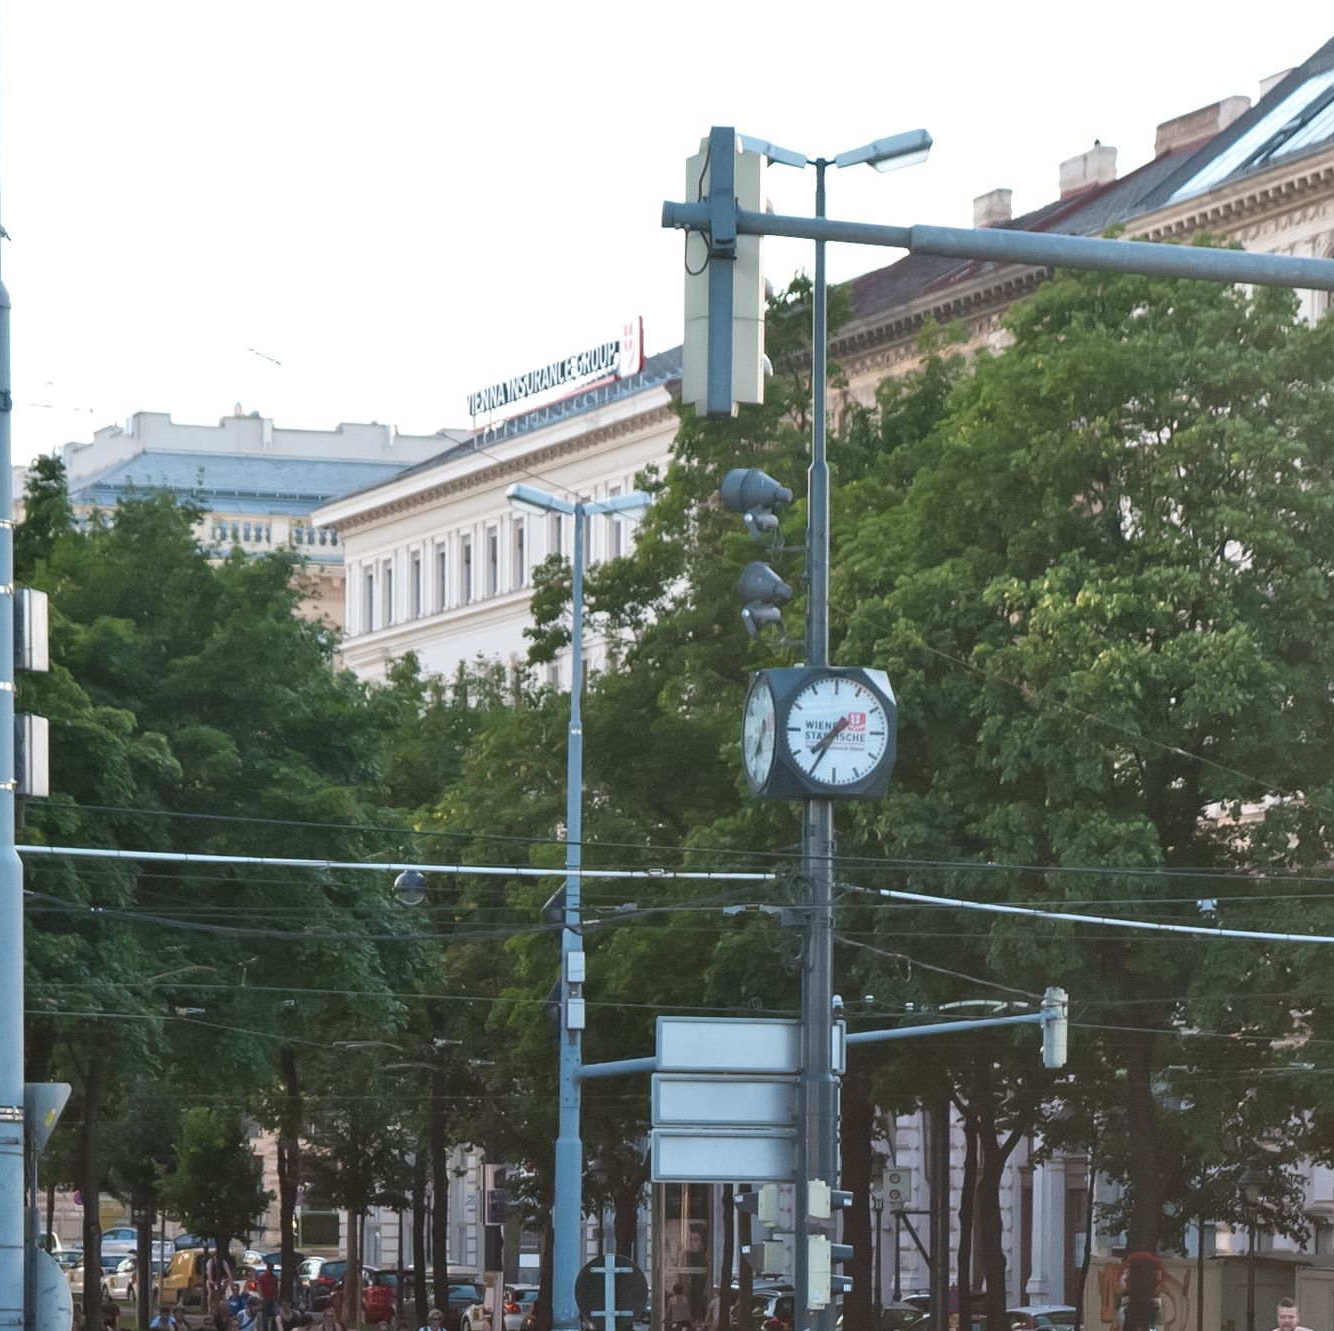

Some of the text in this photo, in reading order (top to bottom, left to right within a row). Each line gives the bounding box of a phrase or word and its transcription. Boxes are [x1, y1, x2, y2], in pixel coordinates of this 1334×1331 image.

[467, 341, 619, 416] VIENNA INSURANCE GROUP
